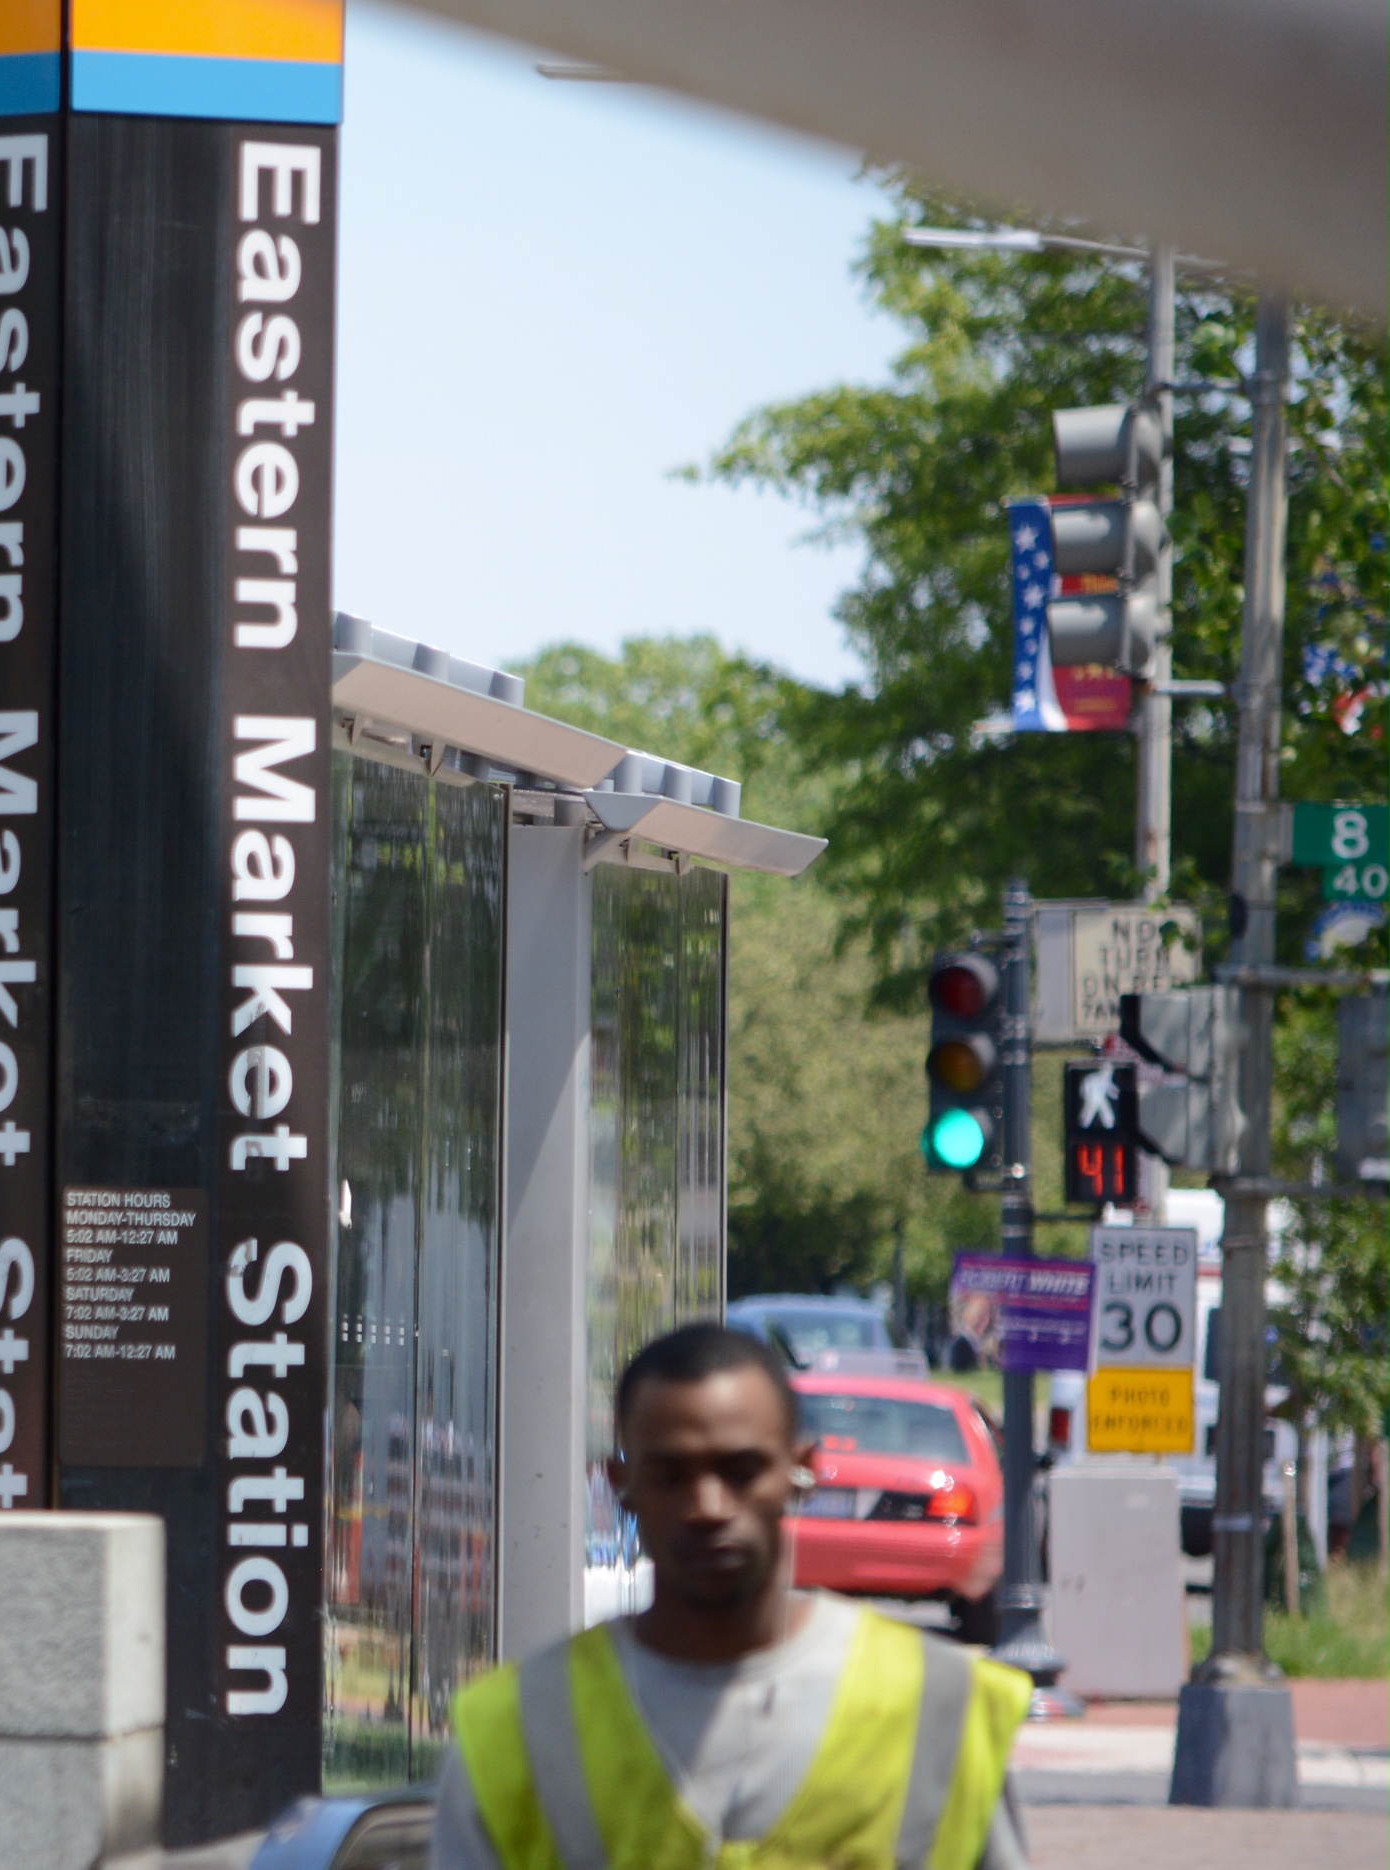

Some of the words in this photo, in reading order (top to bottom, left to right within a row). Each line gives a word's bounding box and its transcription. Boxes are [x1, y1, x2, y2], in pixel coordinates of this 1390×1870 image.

[233, 140, 321, 649] Eastern
[1331, 809, 1370, 859] 8
[1112, 917, 1157, 943] NO
[228, 714, 316, 1171] Market
[1099, 945, 1170, 969] TURN
[1082, 971, 1120, 997] ON
[1077, 1143, 1125, 1197] 41
[67, 1192, 121, 1208] STATION
[124, 1193, 171, 1208] HOURS
[66, 1211, 197, 1227] MONDAY-THURSDAY
[66, 1229, 93, 1244] 5:02
[95, 1230, 154, 1245] AM-12:27
[157, 1230, 179, 1245] AM
[66, 1248, 114, 1264] FRIDAY
[1101, 1236, 1189, 1266] SPEED
[66, 1267, 93, 1282] 5:02
[95, 1268, 146, 1283] AM-3:27
[149, 1268, 171, 1283] AM
[1030, 1271, 1091, 1296] WHITE
[1108, 1271, 1177, 1295] LIMIT
[65, 1287, 135, 1302] SATURDAY
[148, 1307, 170, 1322] AM
[65, 1324, 119, 1340] SUNDAY
[1100, 1301, 1183, 1353] 30
[154, 1345, 177, 1360] AM
[1110, 1384, 1171, 1404] PHOTO
[1091, 1414, 1190, 1434] ENFORCED
[224, 1237, 314, 1716] Station
